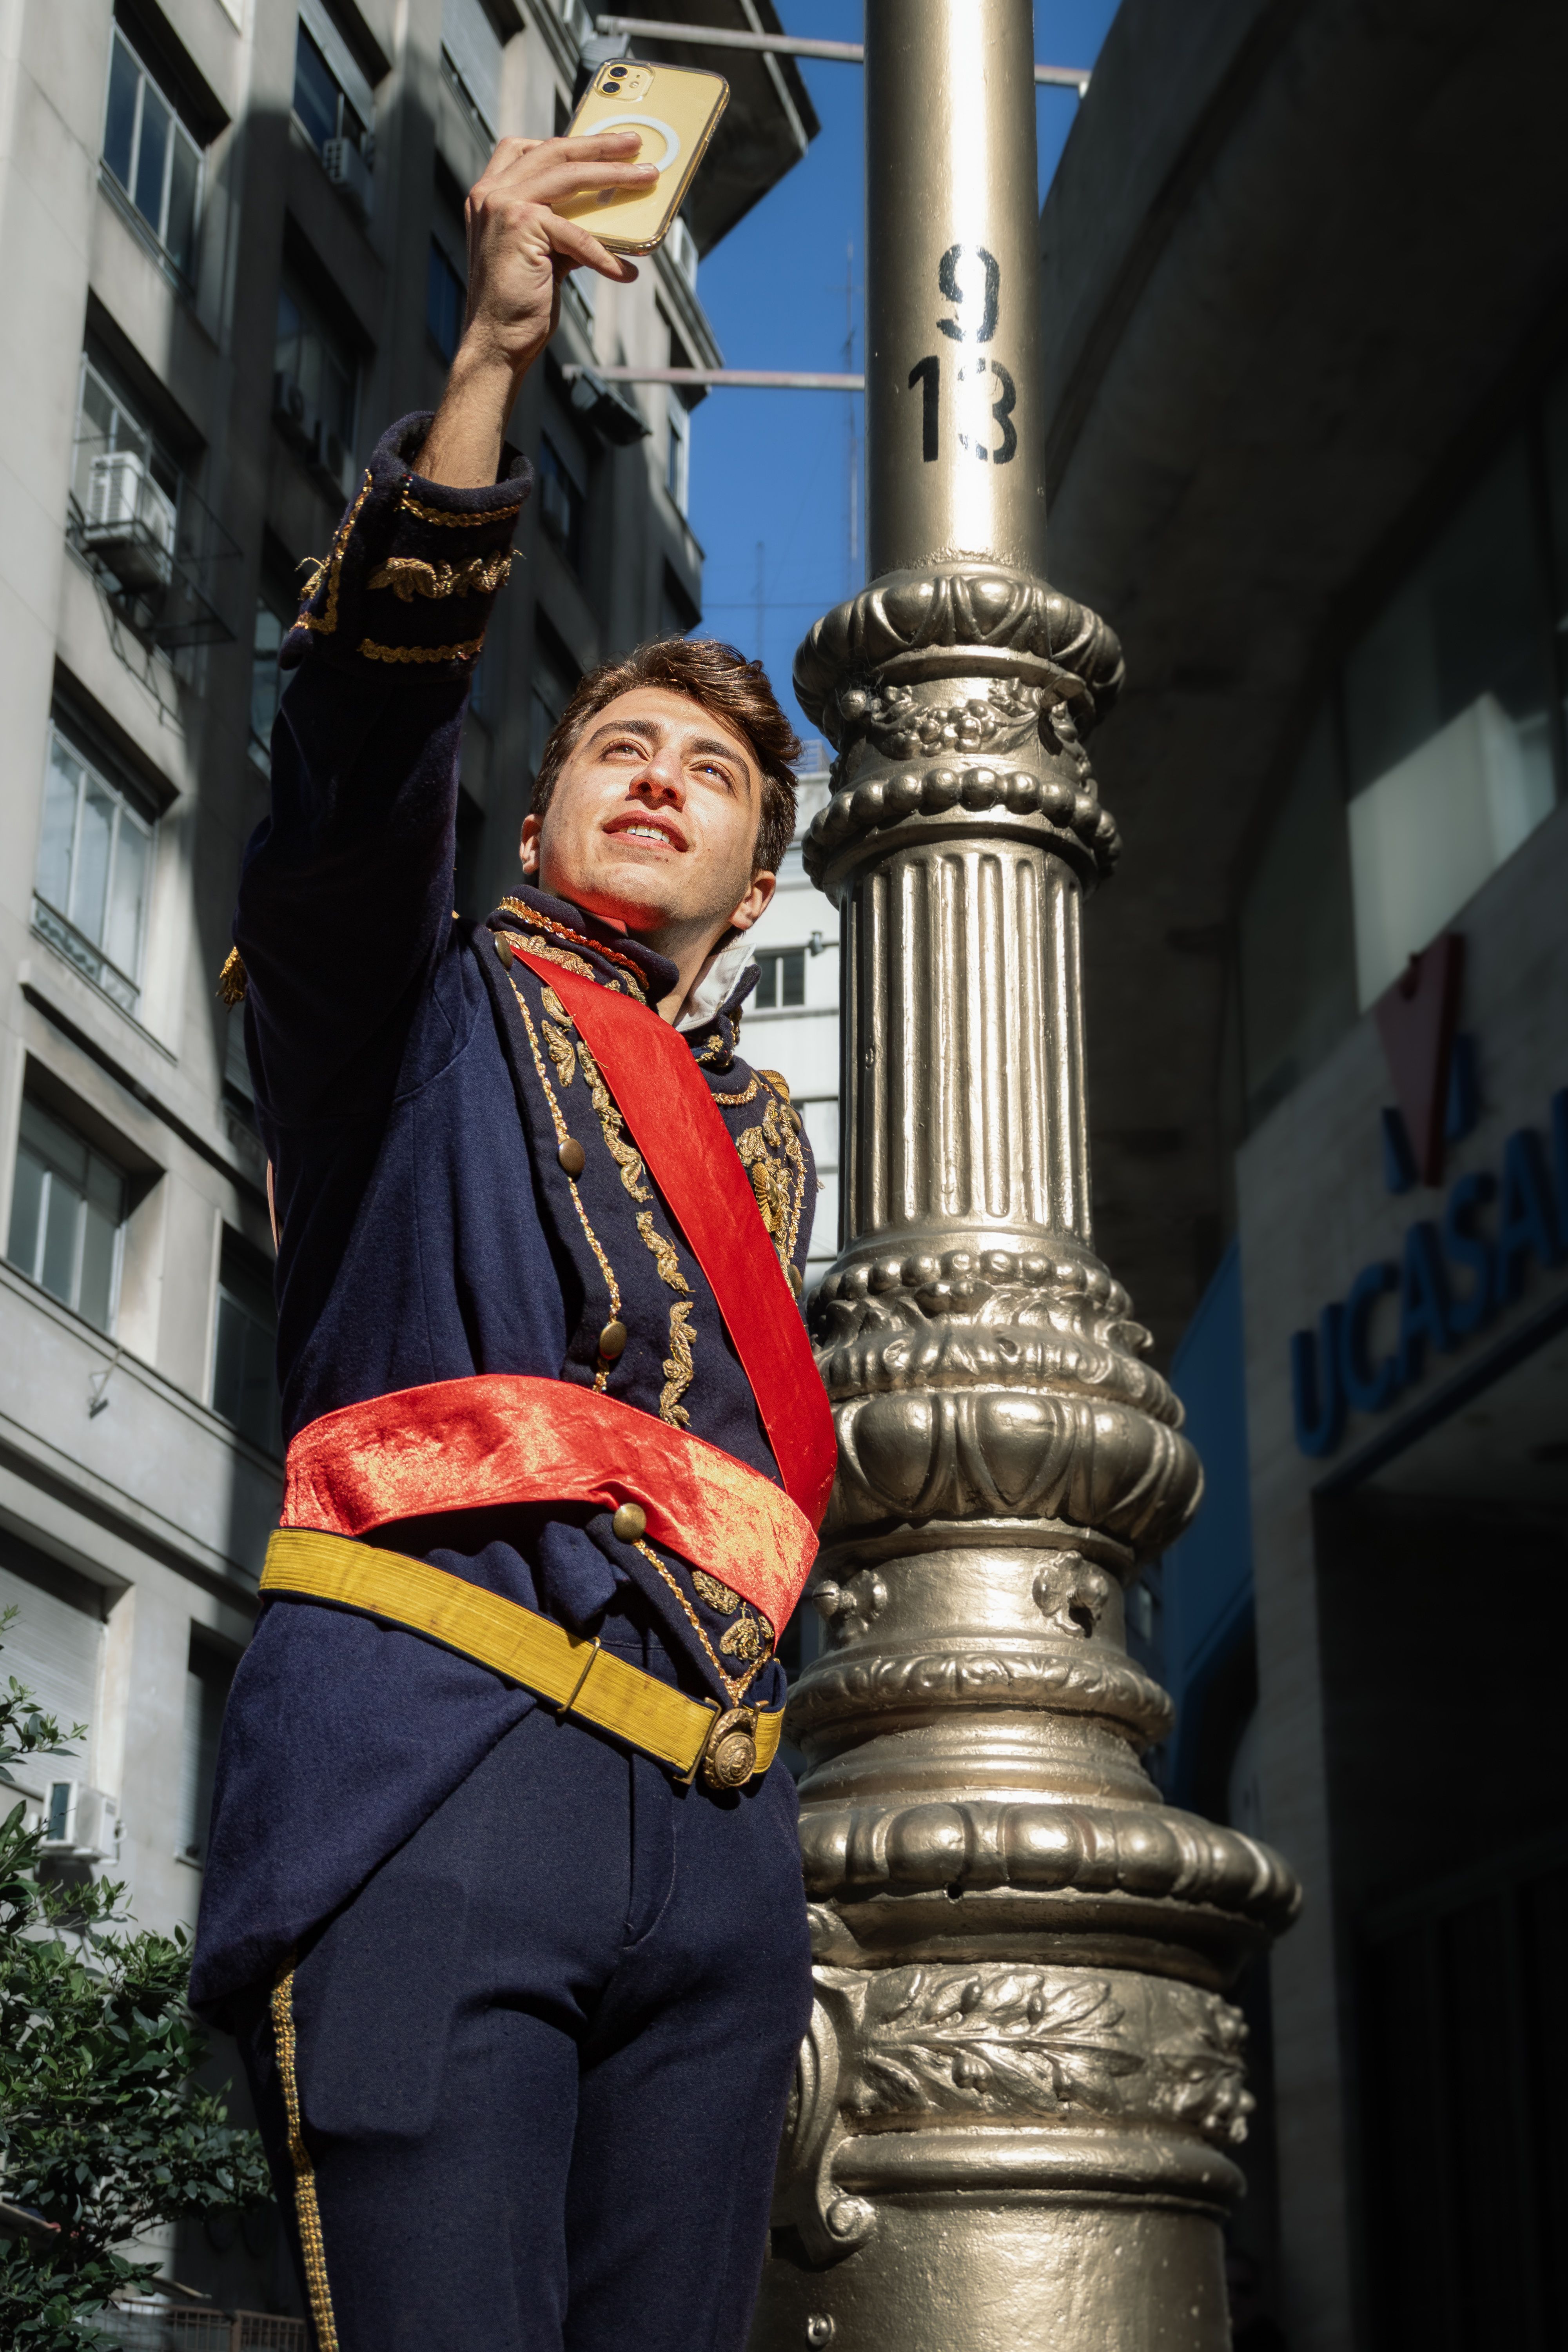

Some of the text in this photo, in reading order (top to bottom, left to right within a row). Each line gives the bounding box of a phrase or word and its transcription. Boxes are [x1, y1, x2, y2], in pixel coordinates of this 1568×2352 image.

[936, 243, 1000, 343] 9
[908, 355, 1018, 465] 13
[1289, 1087, 1568, 1458] UCASA
